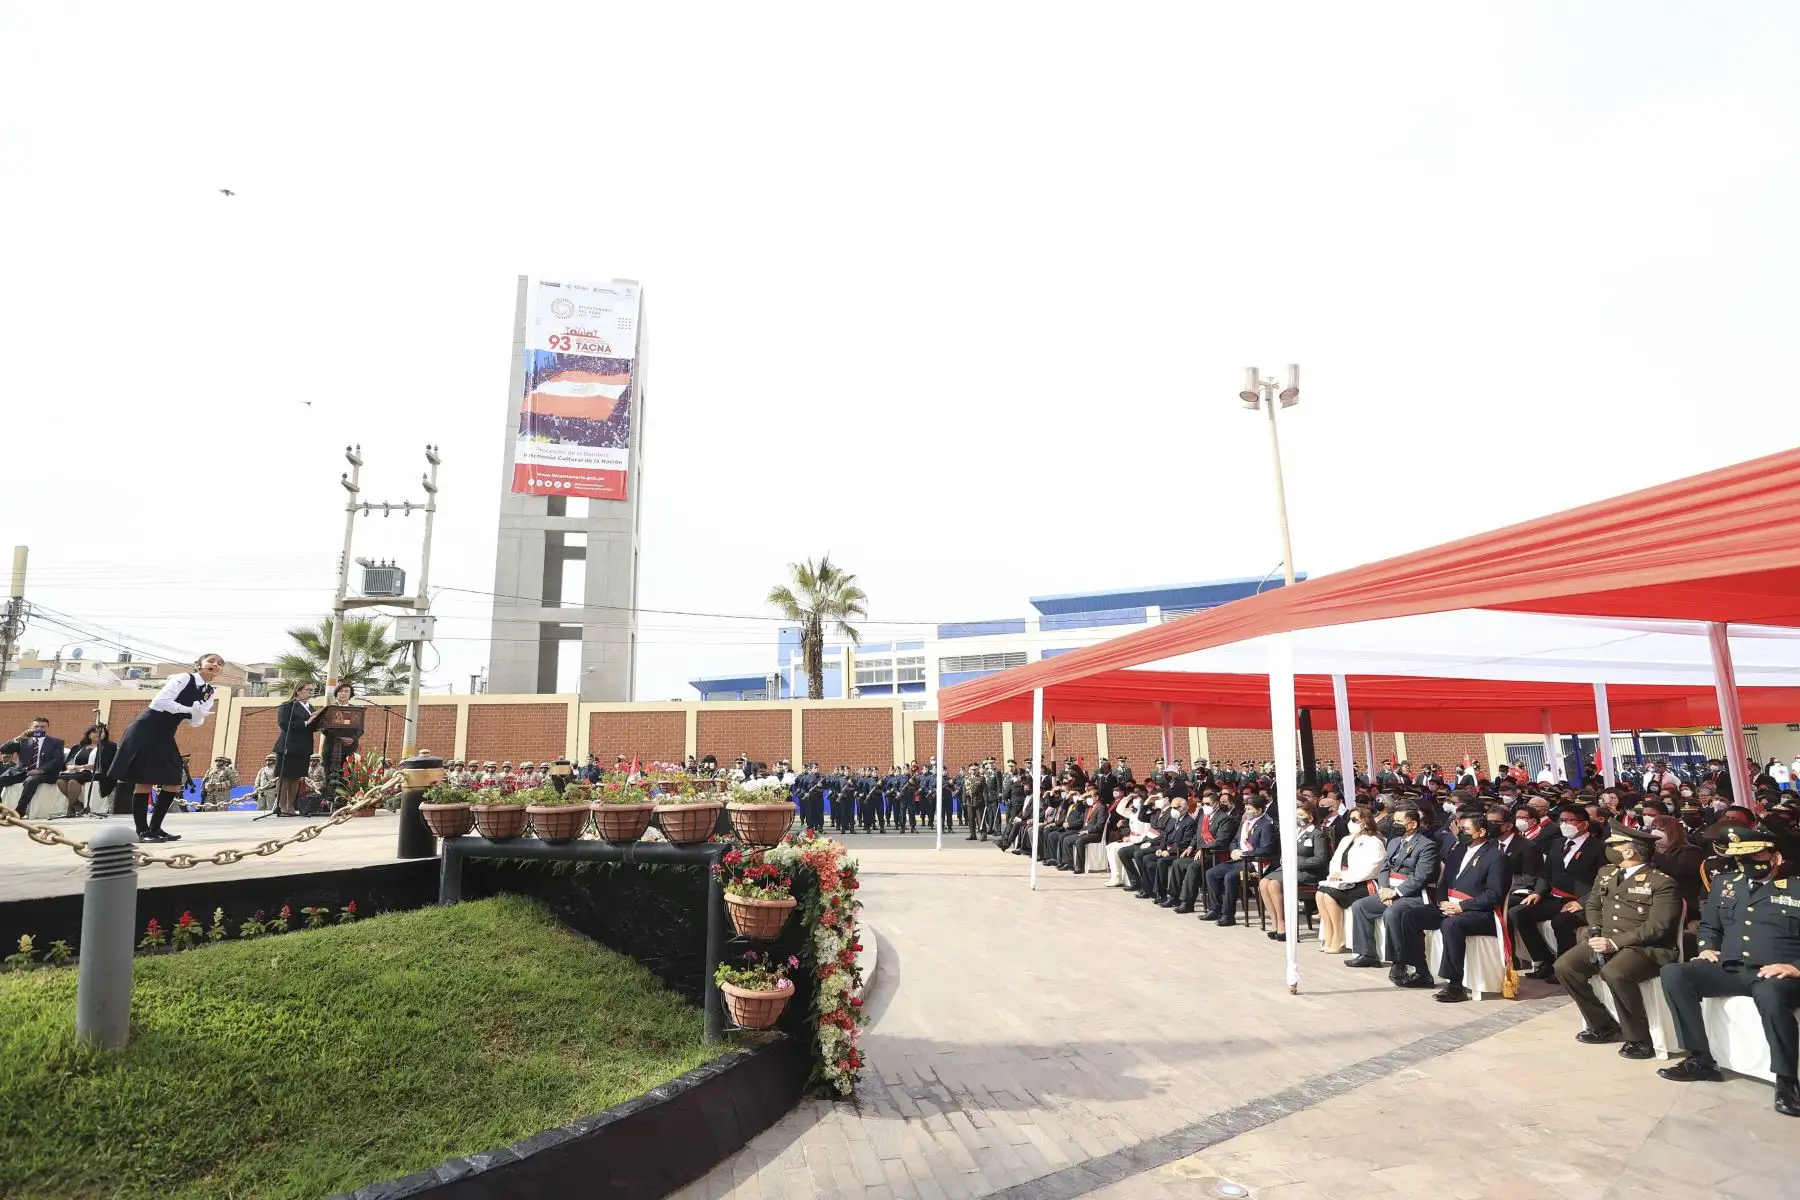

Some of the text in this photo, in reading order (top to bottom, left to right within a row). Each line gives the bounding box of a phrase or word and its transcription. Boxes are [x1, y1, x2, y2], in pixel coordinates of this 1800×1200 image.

[548, 334, 571, 351] 93
[575, 342, 611, 353] TACNA
[557, 455, 584, 463] Cultural
